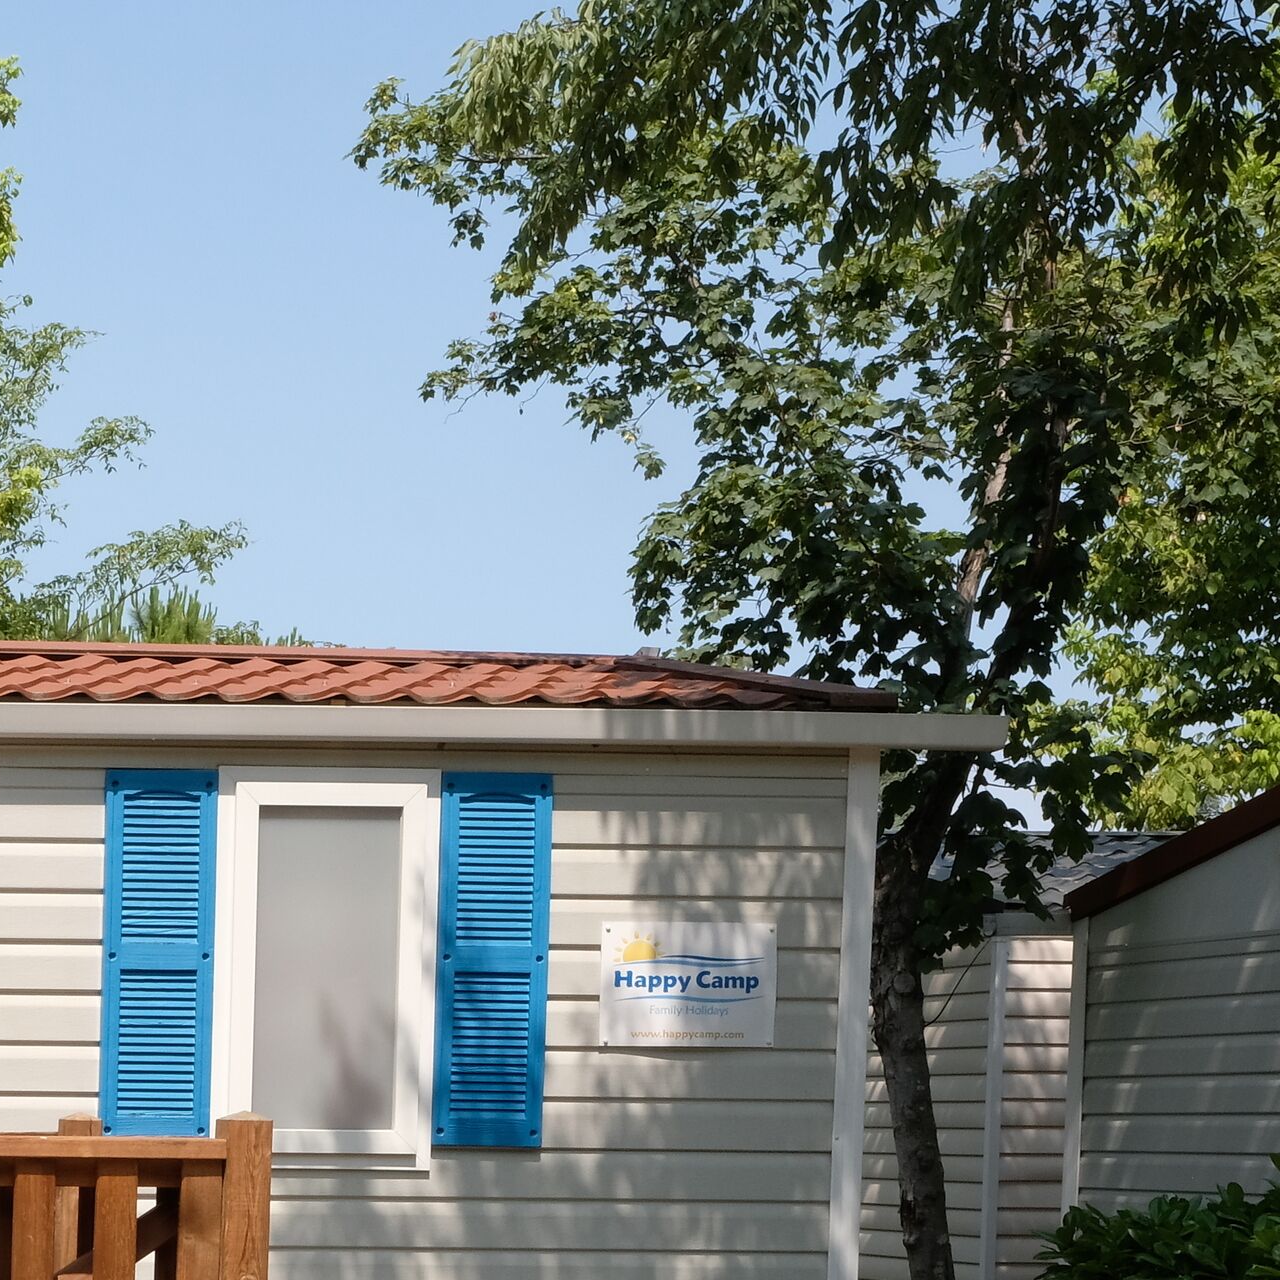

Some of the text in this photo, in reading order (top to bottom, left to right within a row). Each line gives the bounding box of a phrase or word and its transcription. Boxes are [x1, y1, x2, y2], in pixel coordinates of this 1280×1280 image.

[614, 970, 759, 993] Happy Camp
[649, 1005, 729, 1017] Family Holidays
[631, 1030, 745, 1040] www.happycamp.com
